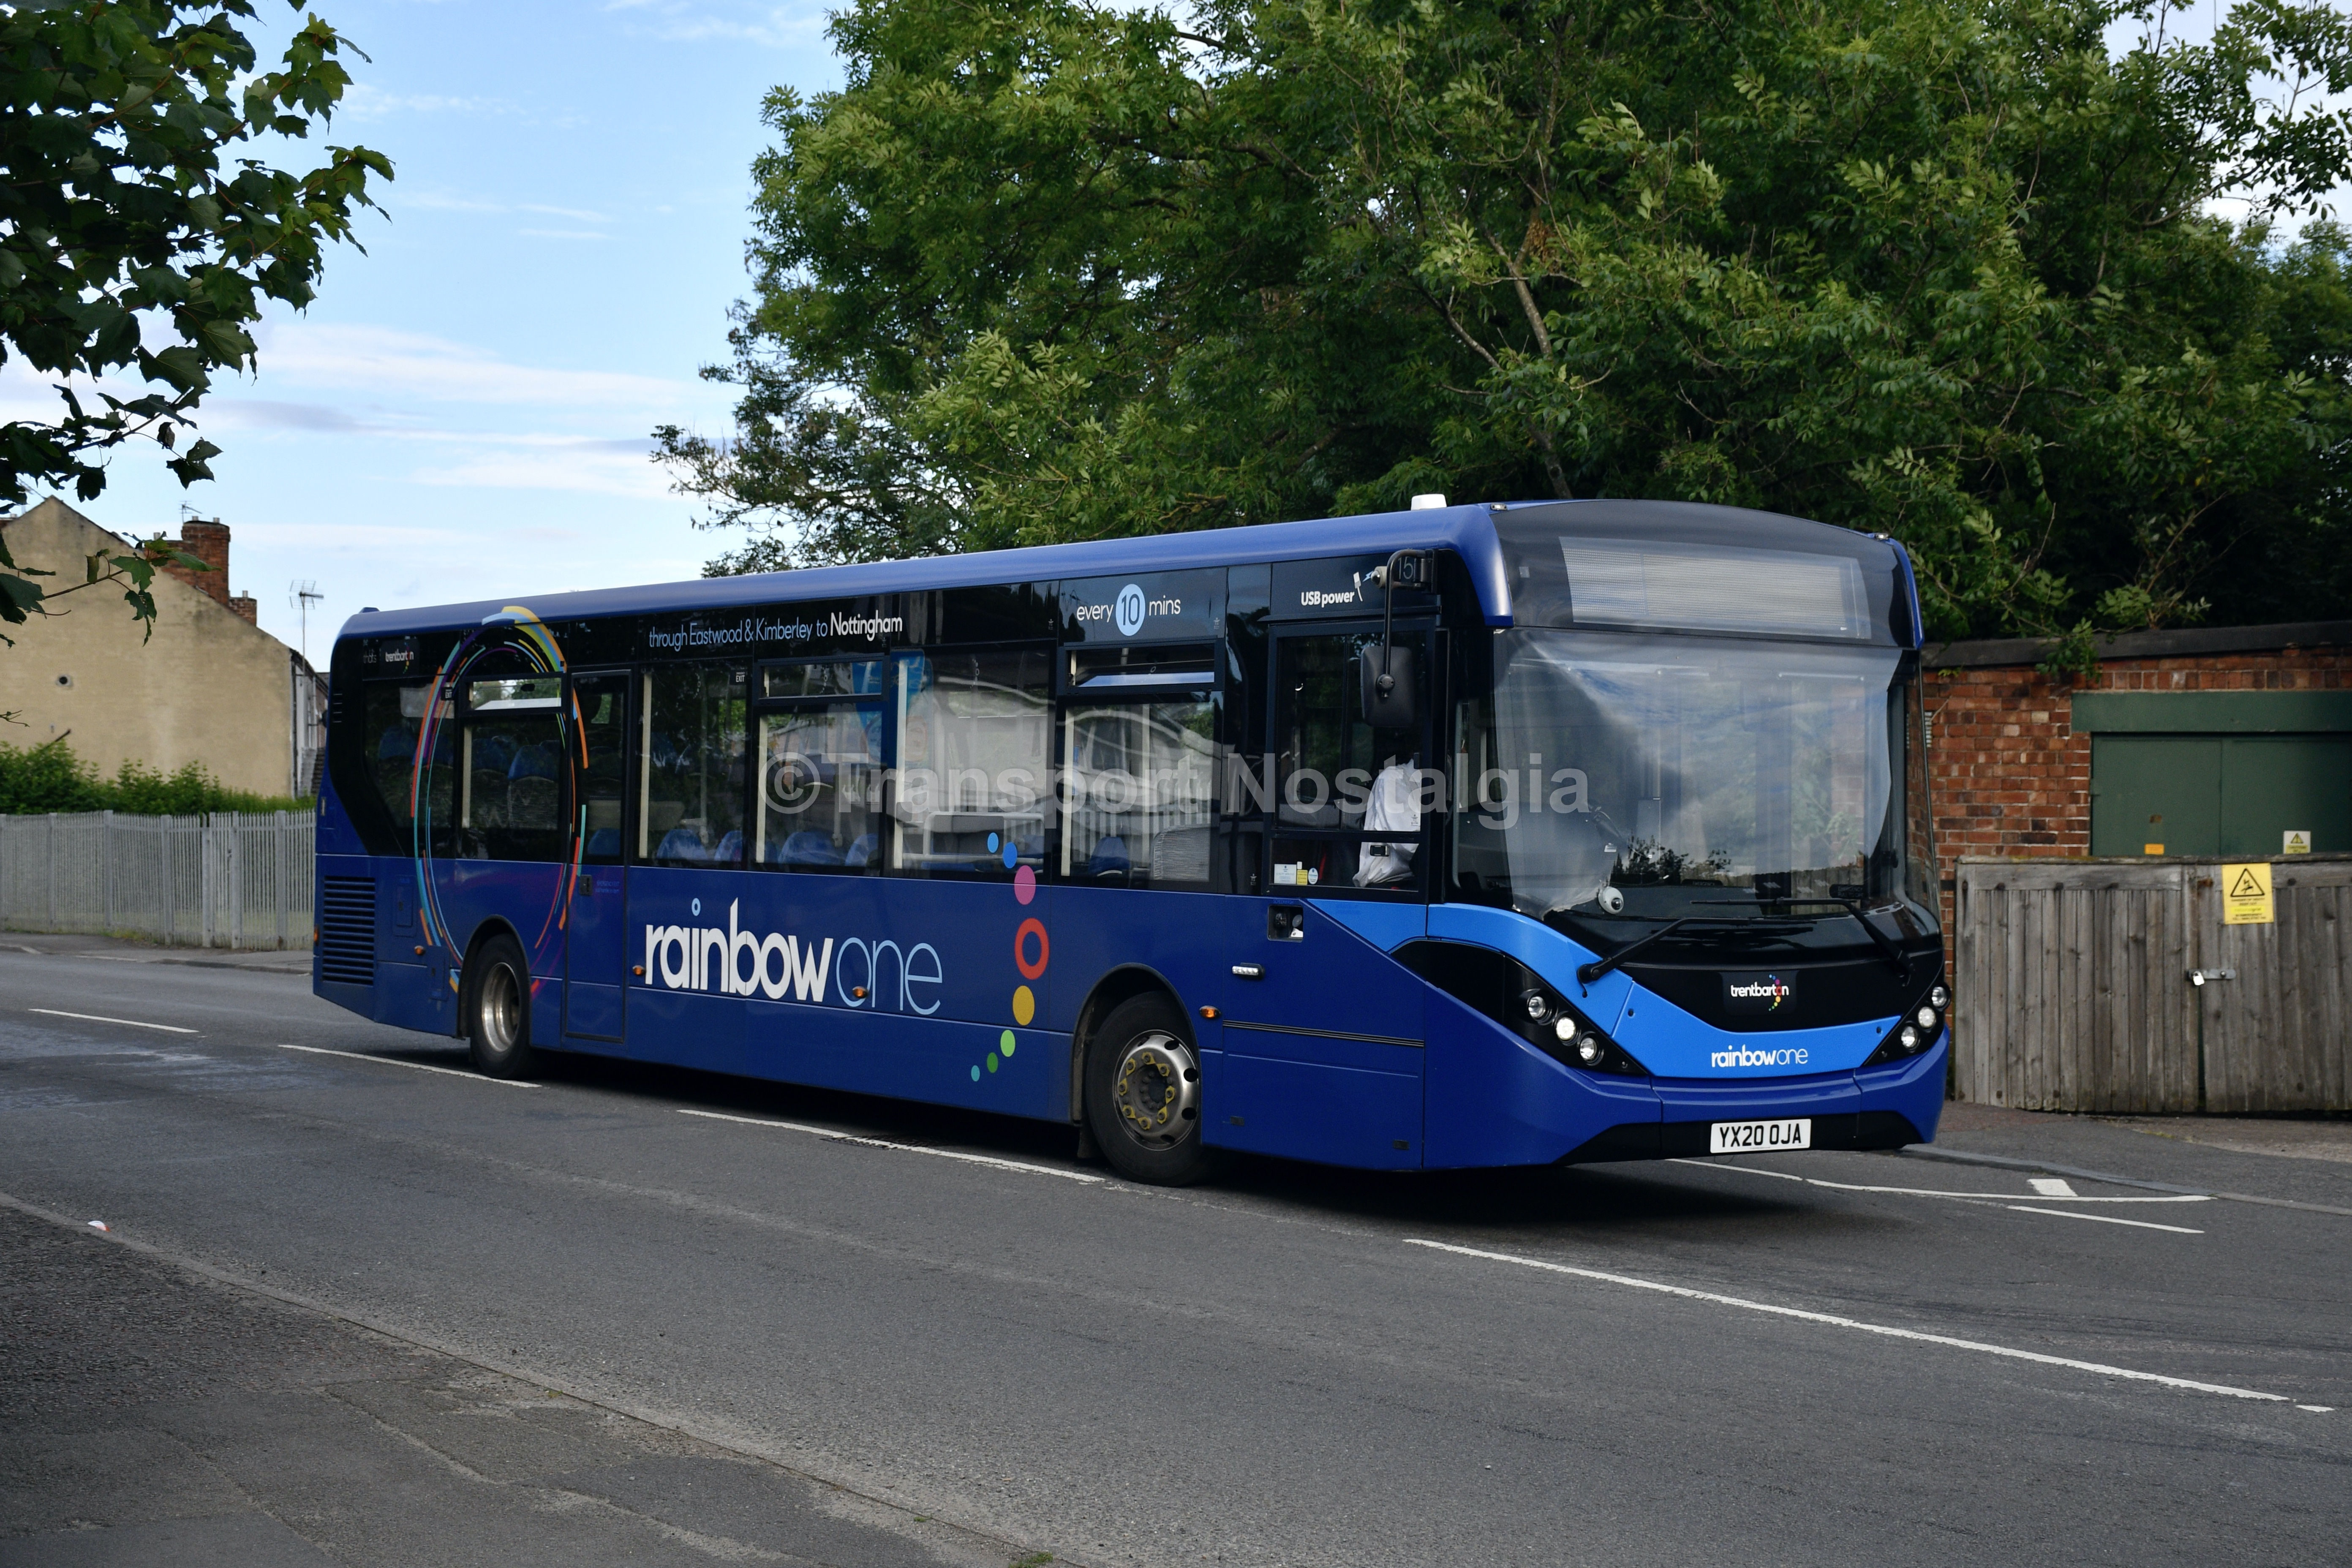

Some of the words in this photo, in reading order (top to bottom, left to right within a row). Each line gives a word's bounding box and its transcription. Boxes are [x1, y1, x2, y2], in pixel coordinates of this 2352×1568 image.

[1076, 604, 1114, 623] every
[1122, 593, 1140, 626] 10
[1149, 595, 1181, 616] mins
[1301, 591, 1321, 606] USB
[1321, 591, 1355, 608] power
[649, 625, 687, 652] through
[690, 620, 742, 645] Eastwood
[744, 618, 754, 642] &
[756, 616, 813, 641] Kimberley
[816, 620, 828, 637] to
[830, 610, 903, 641] Nottingham
[1730, 981, 1789, 997] trentbarton
[1720, 1125, 1764, 1147] YX20
[1769, 1123, 1802, 1145] OJA
